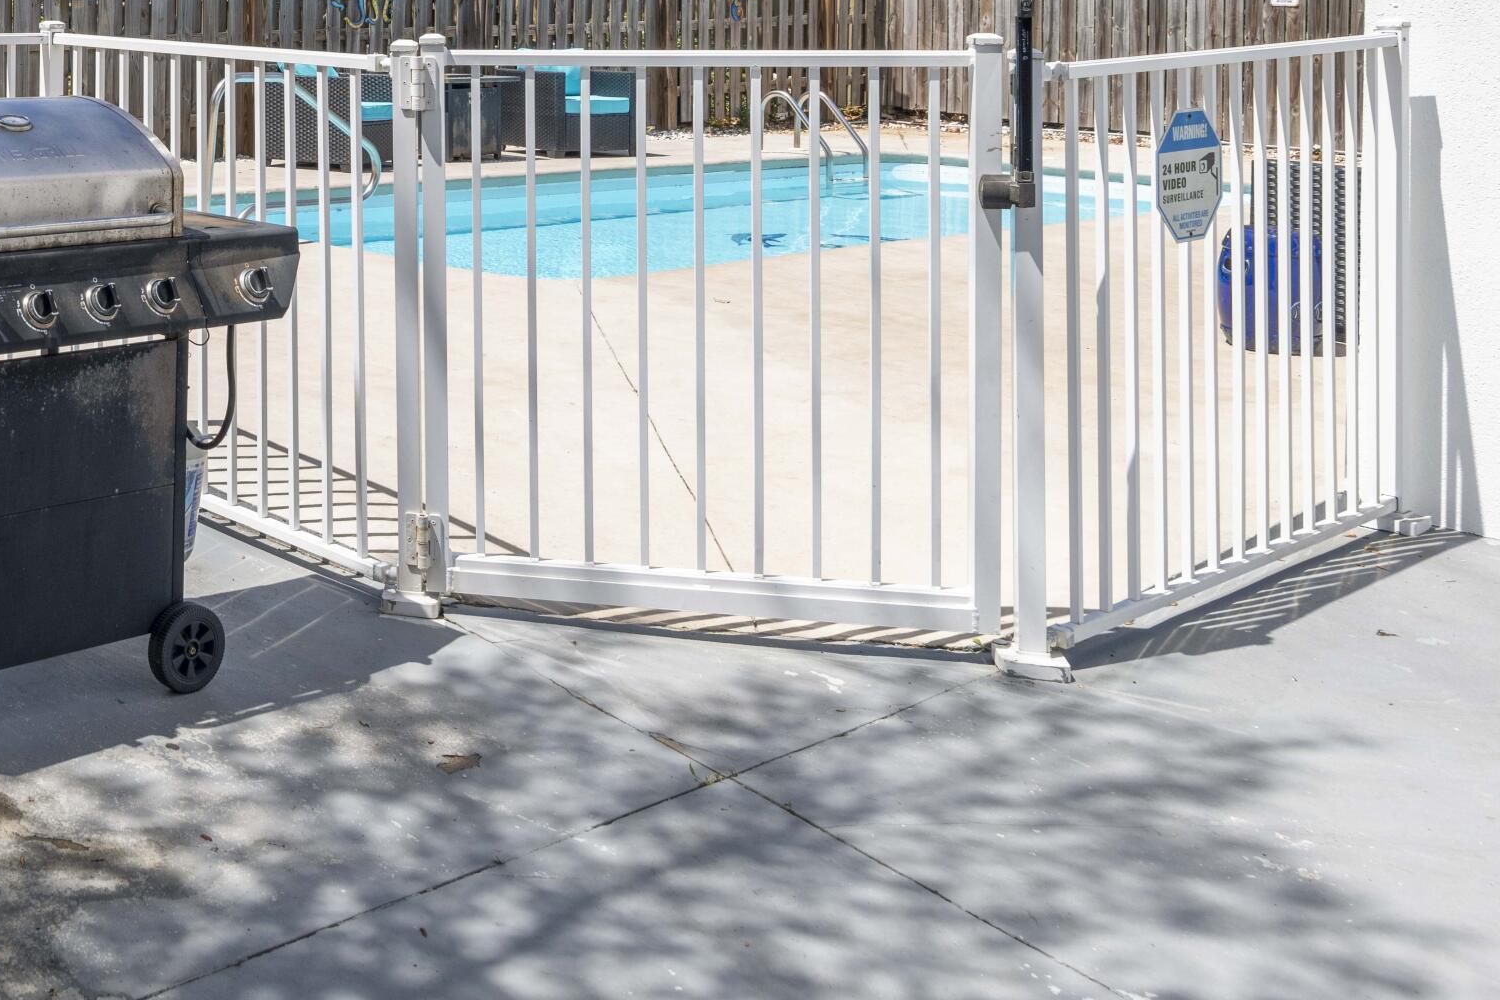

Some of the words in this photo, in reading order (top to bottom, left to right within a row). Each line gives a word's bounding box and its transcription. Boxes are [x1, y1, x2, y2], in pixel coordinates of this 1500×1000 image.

[1173, 123, 1207, 141] WARNING!
[1162, 164, 1172, 176] 24
[1174, 160, 1197, 174] HOUR
[1162, 177, 1187, 191] VIDEO
[1162, 189, 1204, 205] SURVEILLANCE
